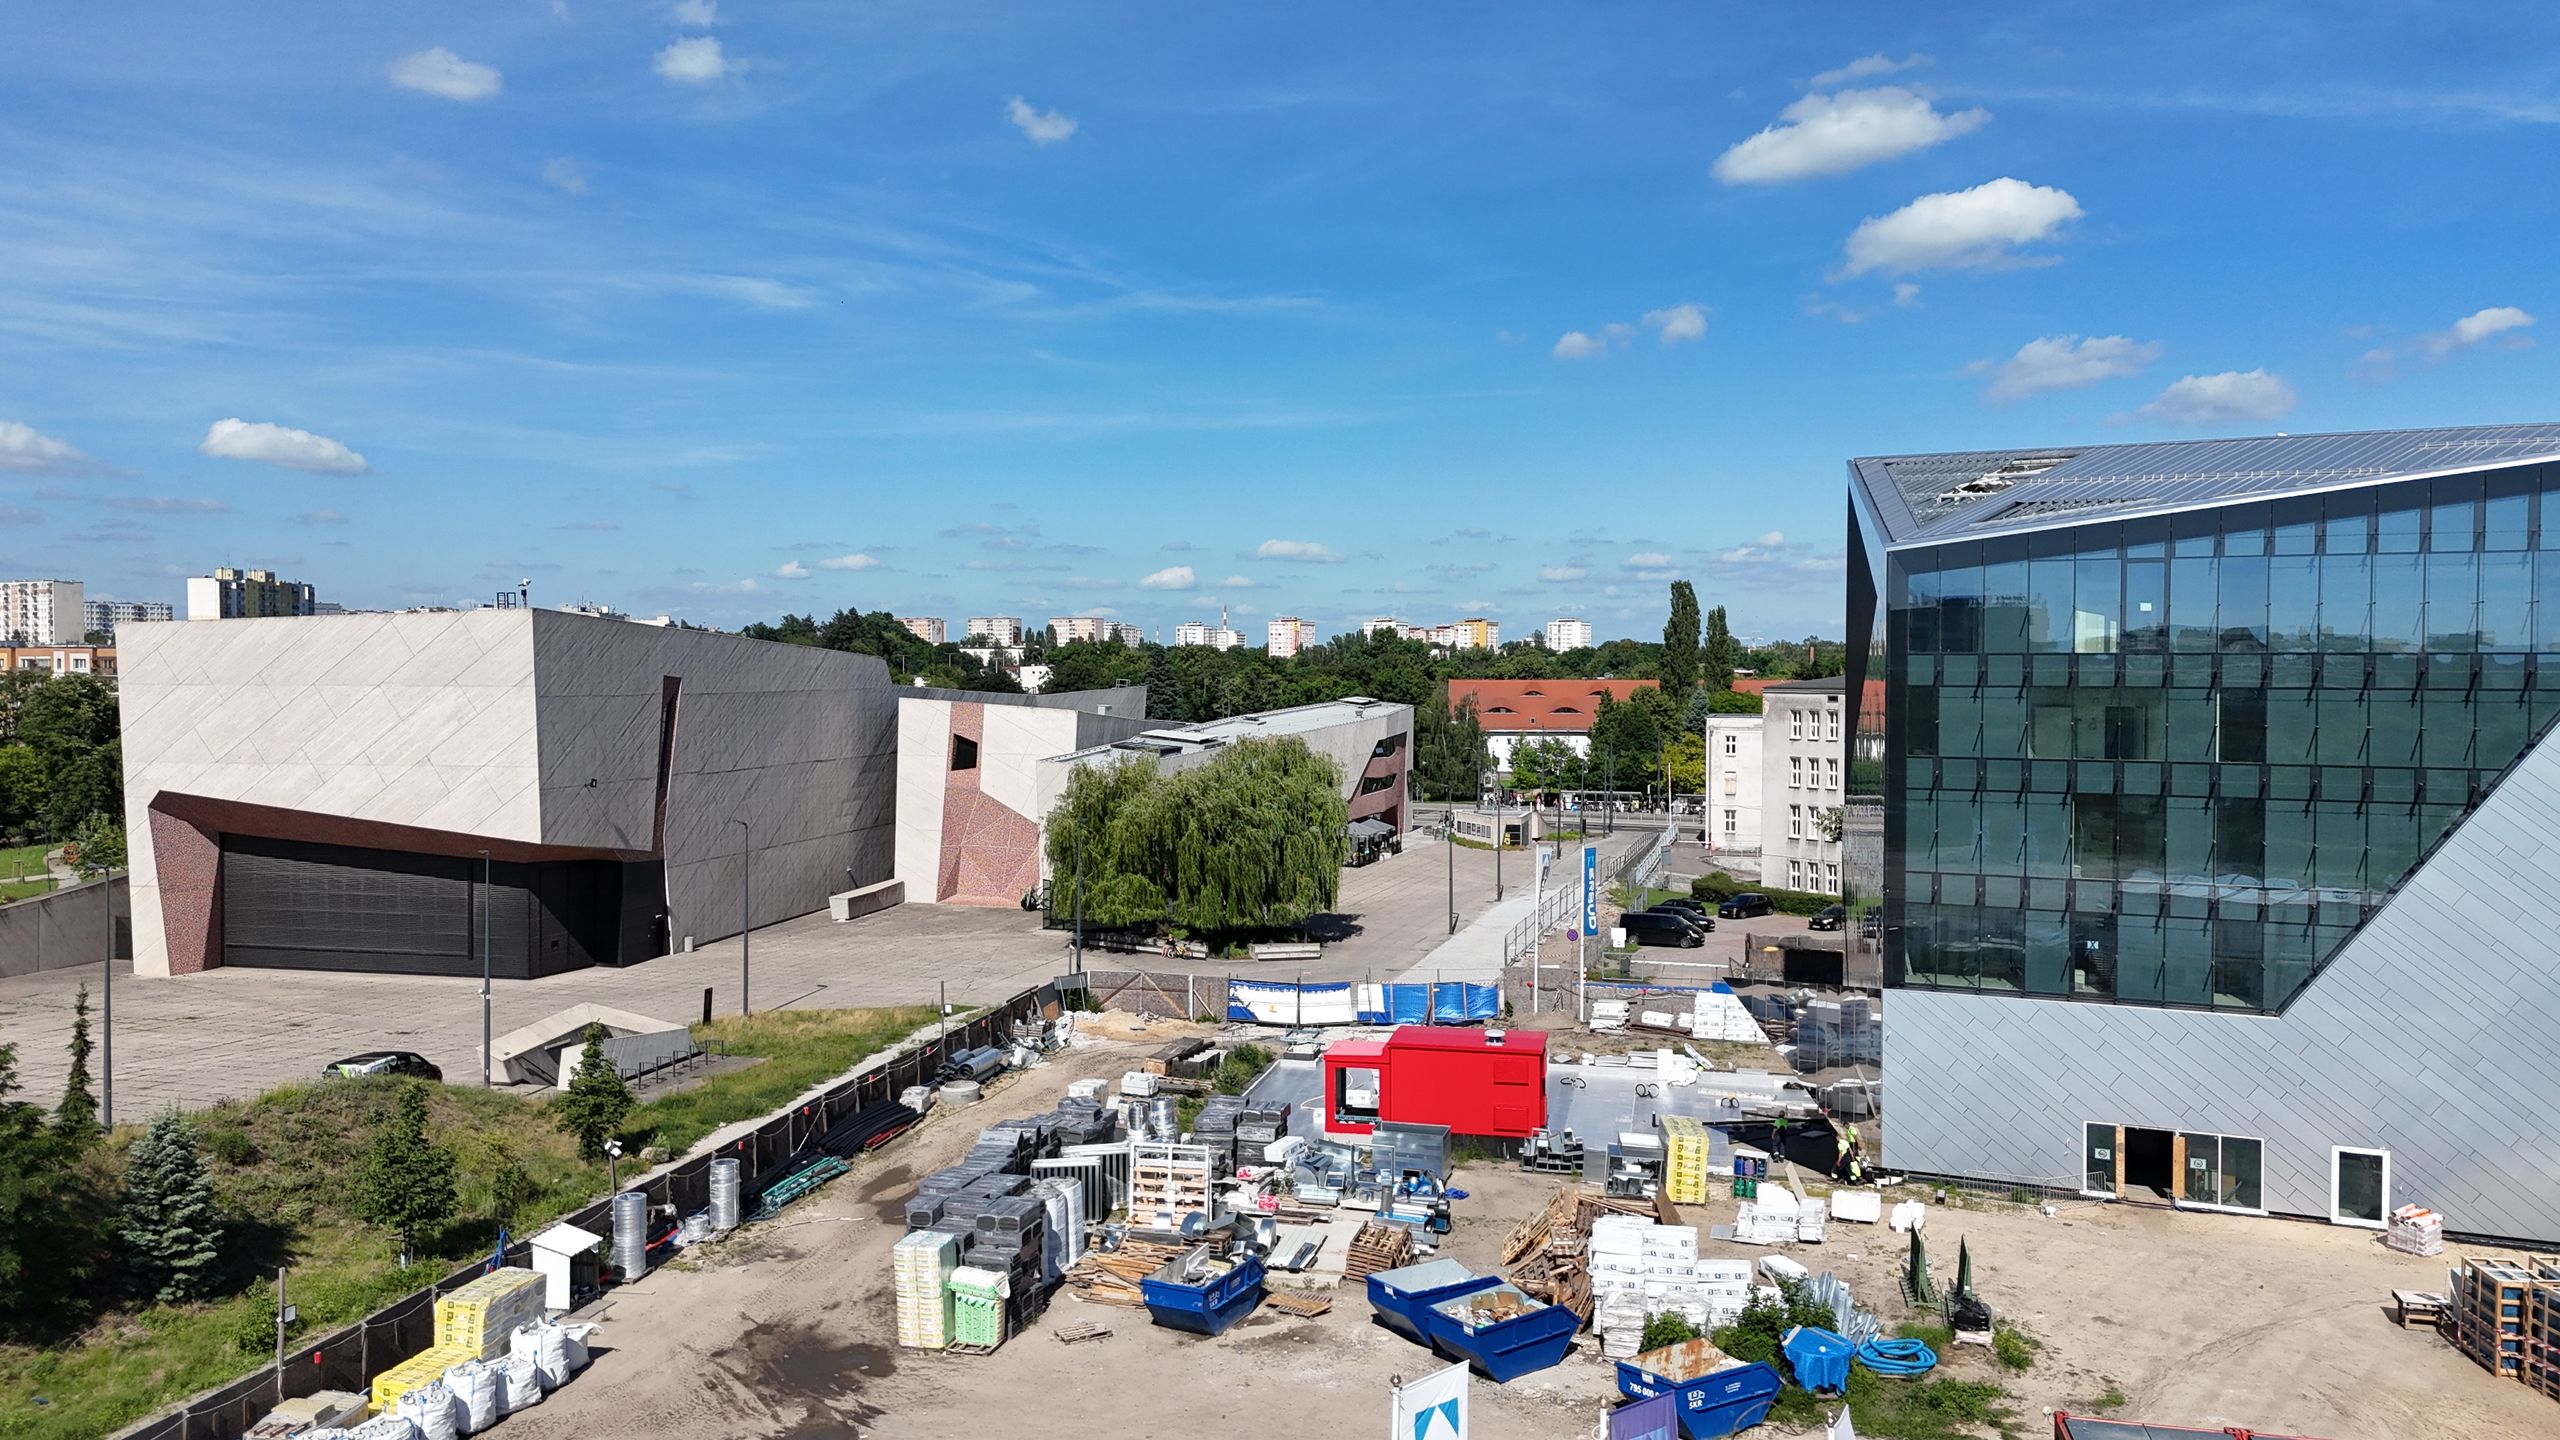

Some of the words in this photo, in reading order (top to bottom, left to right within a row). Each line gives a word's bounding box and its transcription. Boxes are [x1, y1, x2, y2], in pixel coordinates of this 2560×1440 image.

[1587, 867, 1597, 930] ERBUD
[1629, 1382, 1642, 1394] 795
[1689, 1399, 1703, 1410] SKR
